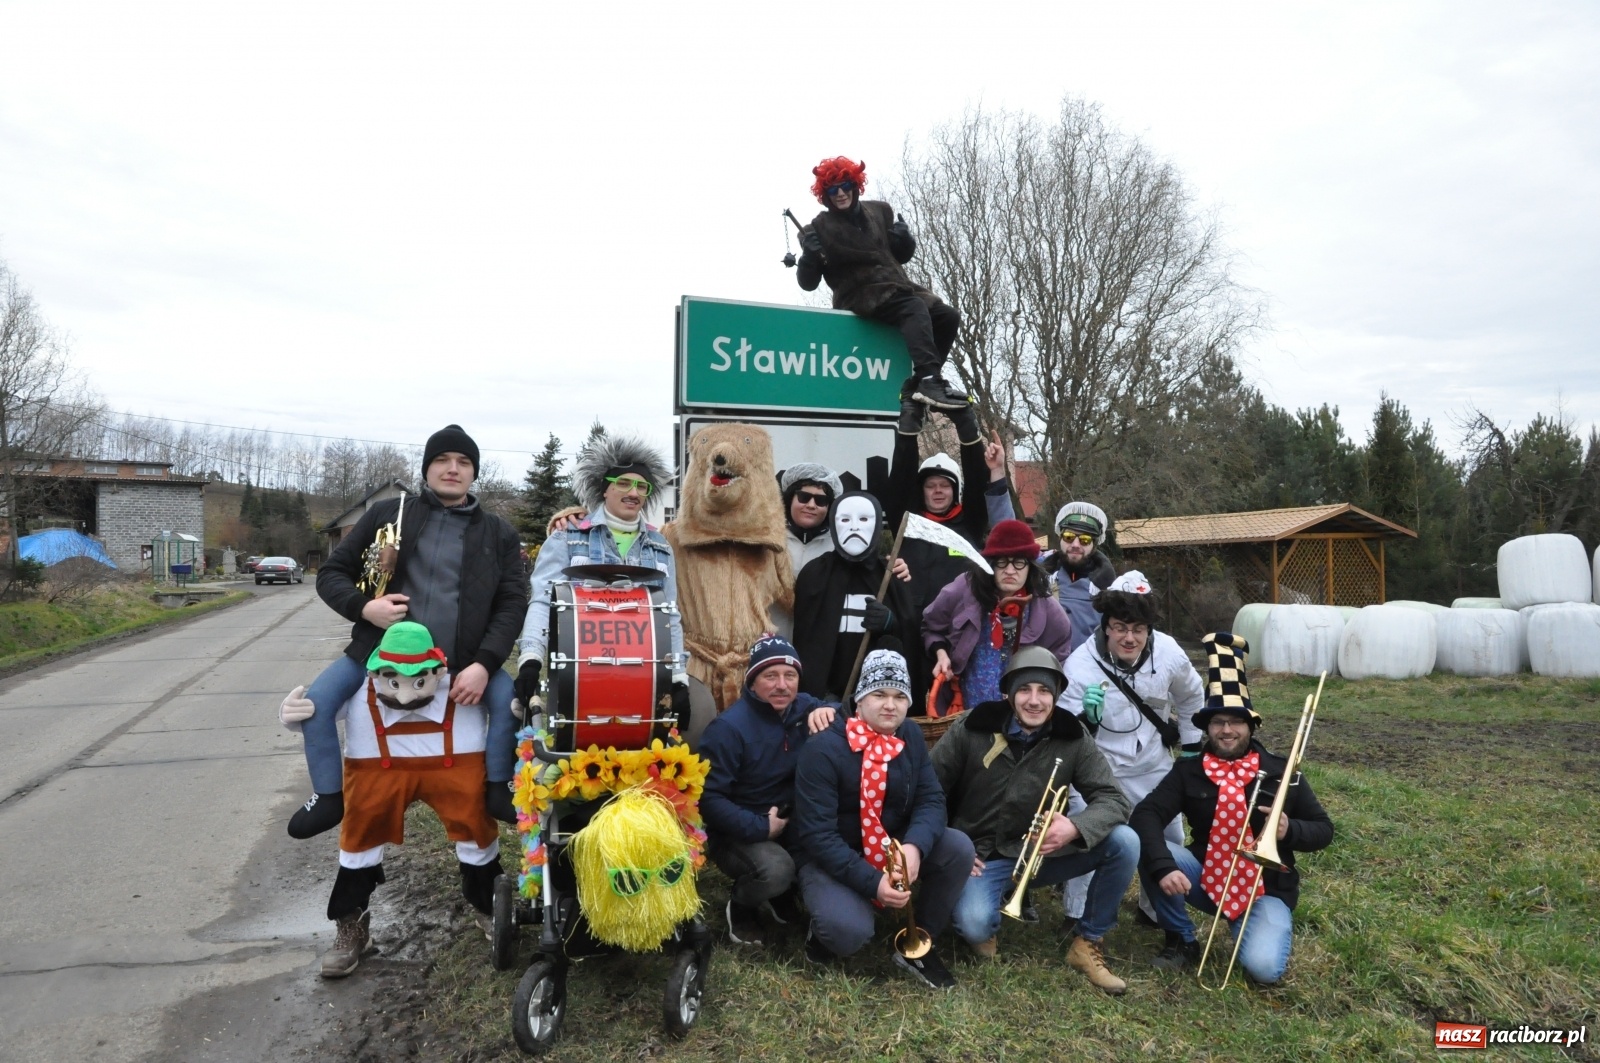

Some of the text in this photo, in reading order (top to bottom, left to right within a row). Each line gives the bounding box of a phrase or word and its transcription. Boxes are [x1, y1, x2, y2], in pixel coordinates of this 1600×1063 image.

[710, 335, 891, 381] Sławików
[580, 620, 648, 645] BERY
[601, 647, 616, 658] 20
